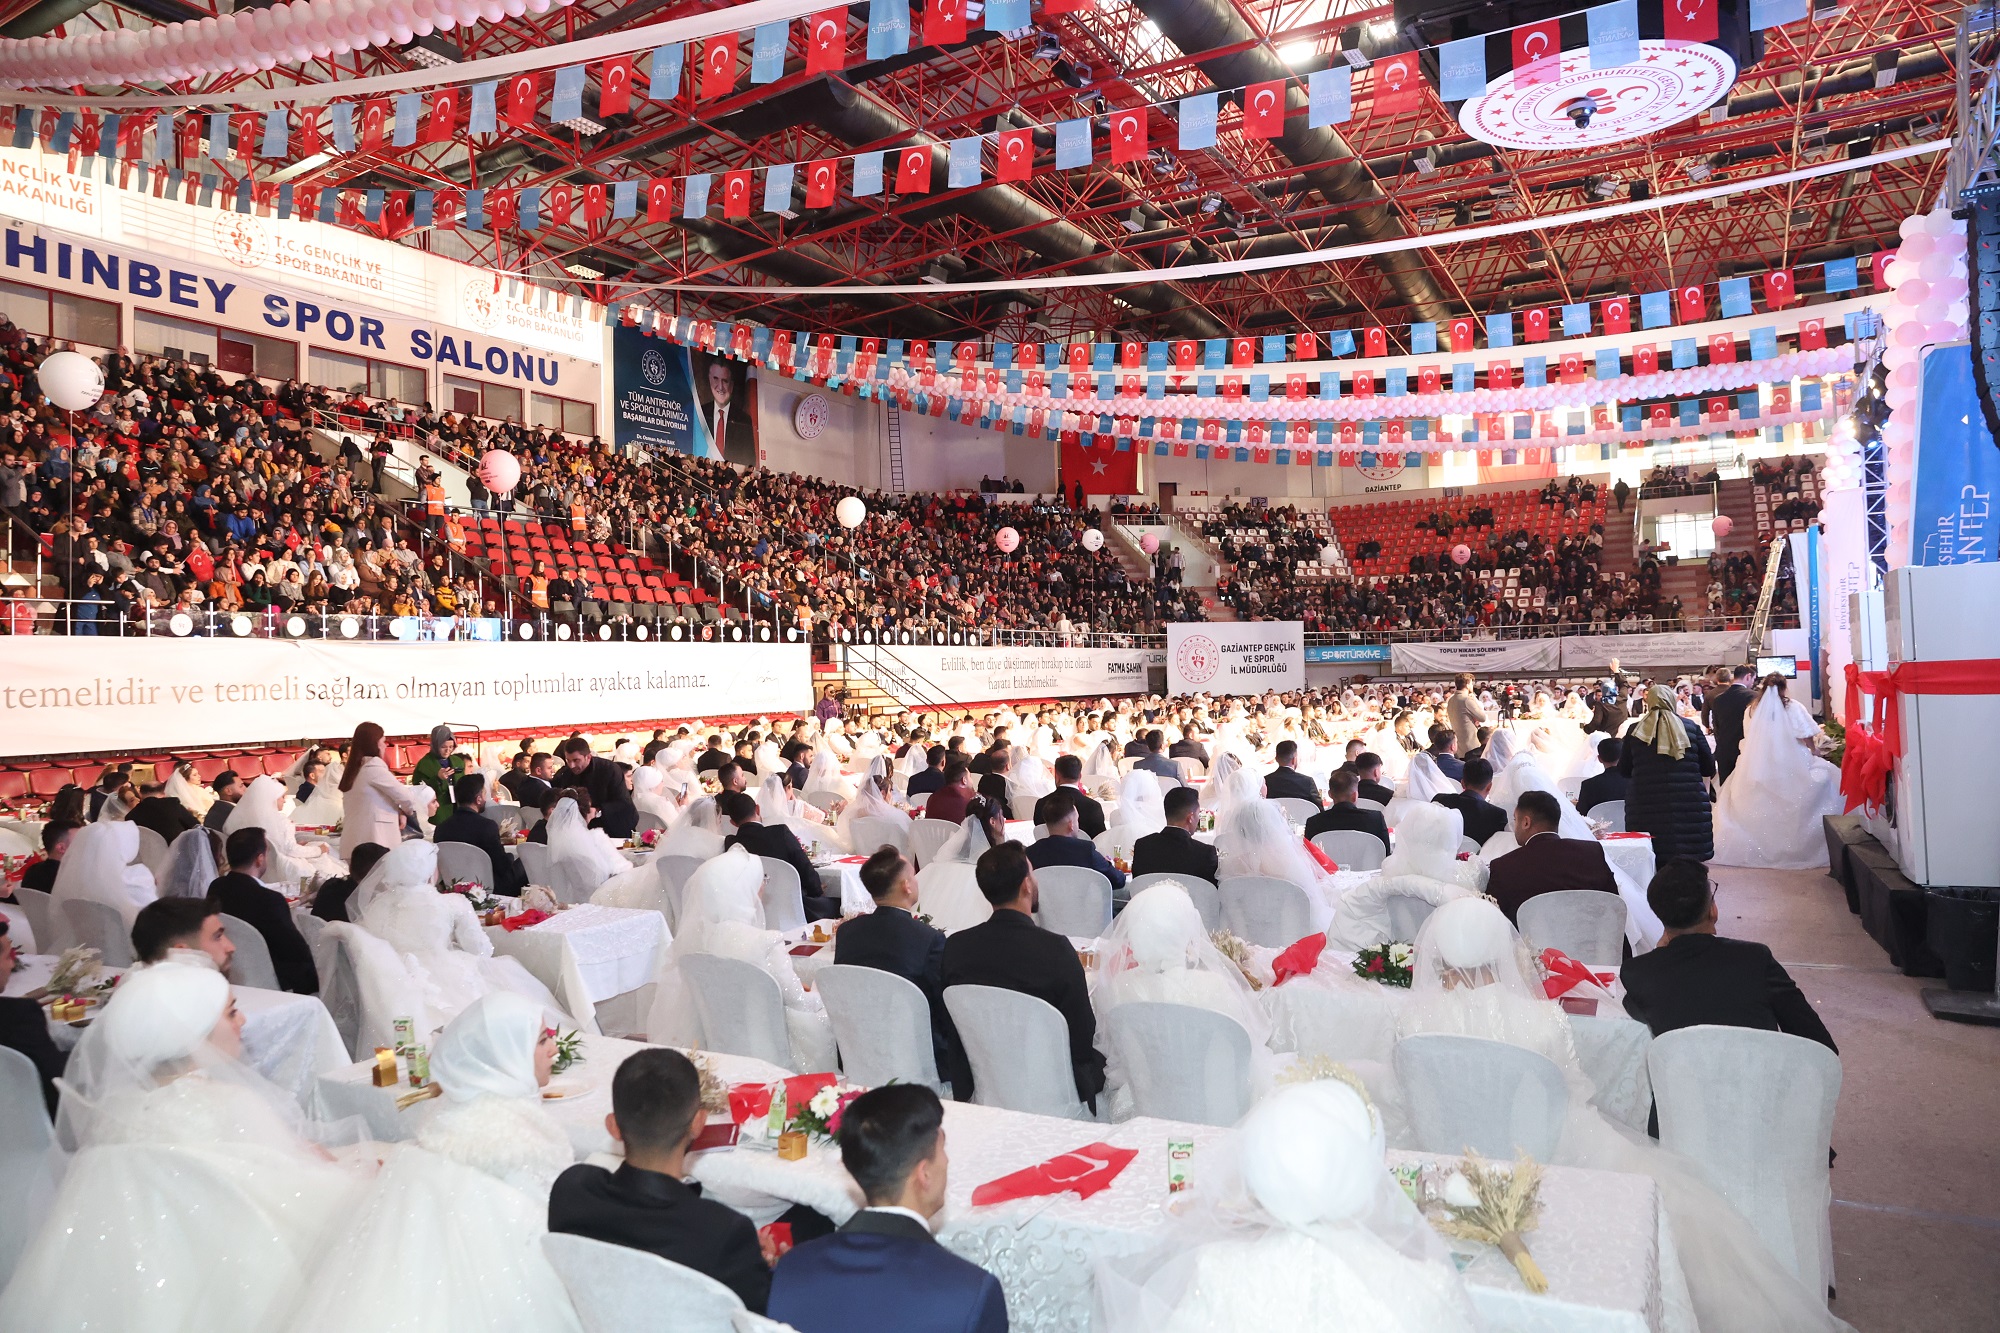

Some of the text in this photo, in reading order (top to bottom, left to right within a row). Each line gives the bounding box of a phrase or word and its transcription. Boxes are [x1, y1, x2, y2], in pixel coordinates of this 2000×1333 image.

[0, 179, 93, 215] AKANLIĞI
[69, 178, 93, 197] VE
[274, 235, 382, 275] T.C. GENÇLİK VE
[5, 228, 237, 314] HINBEY
[274, 252, 383, 291] SPOR BAKANLIĞI
[506, 300, 583, 329] T.C. GENÇLİK VE
[506, 314, 532, 330] SPOR
[262, 294, 559, 386] SPOR SALONU
[620, 399, 689, 423] VE SPORCULARIMIZA
[627, 391, 682, 412] TÜM ANTRENÖR
[622, 411, 687, 431] BAŞARILAR DİLİYORUM
[1364, 483, 1402, 493] GAZİANTEP
[1221, 642, 1296, 653] GAZİANTEP GENÇLİK
[941, 657, 969, 672] Evlilik,
[971, 658, 984, 671] ben
[986, 657, 1002, 675] diye
[1064, 657, 1074, 670] biz
[1074, 657, 1093, 669] olarak
[1107, 662, 1125, 674] FATMA
[1243, 654, 1275, 663] VE SPOR
[1230, 663, 1287, 675] İL MÜDÜRLÜĞÜ
[3, 677, 161, 709] temelidir
[172, 684, 204, 704] ve
[214, 676, 300, 702] temeli
[305, 676, 390, 708] sağlam
[396, 676, 486, 704] olmayan
[493, 673, 584, 704] toplumlar
[589, 671, 642, 697] ayakta
[646, 670, 711, 690] kalamaz.
